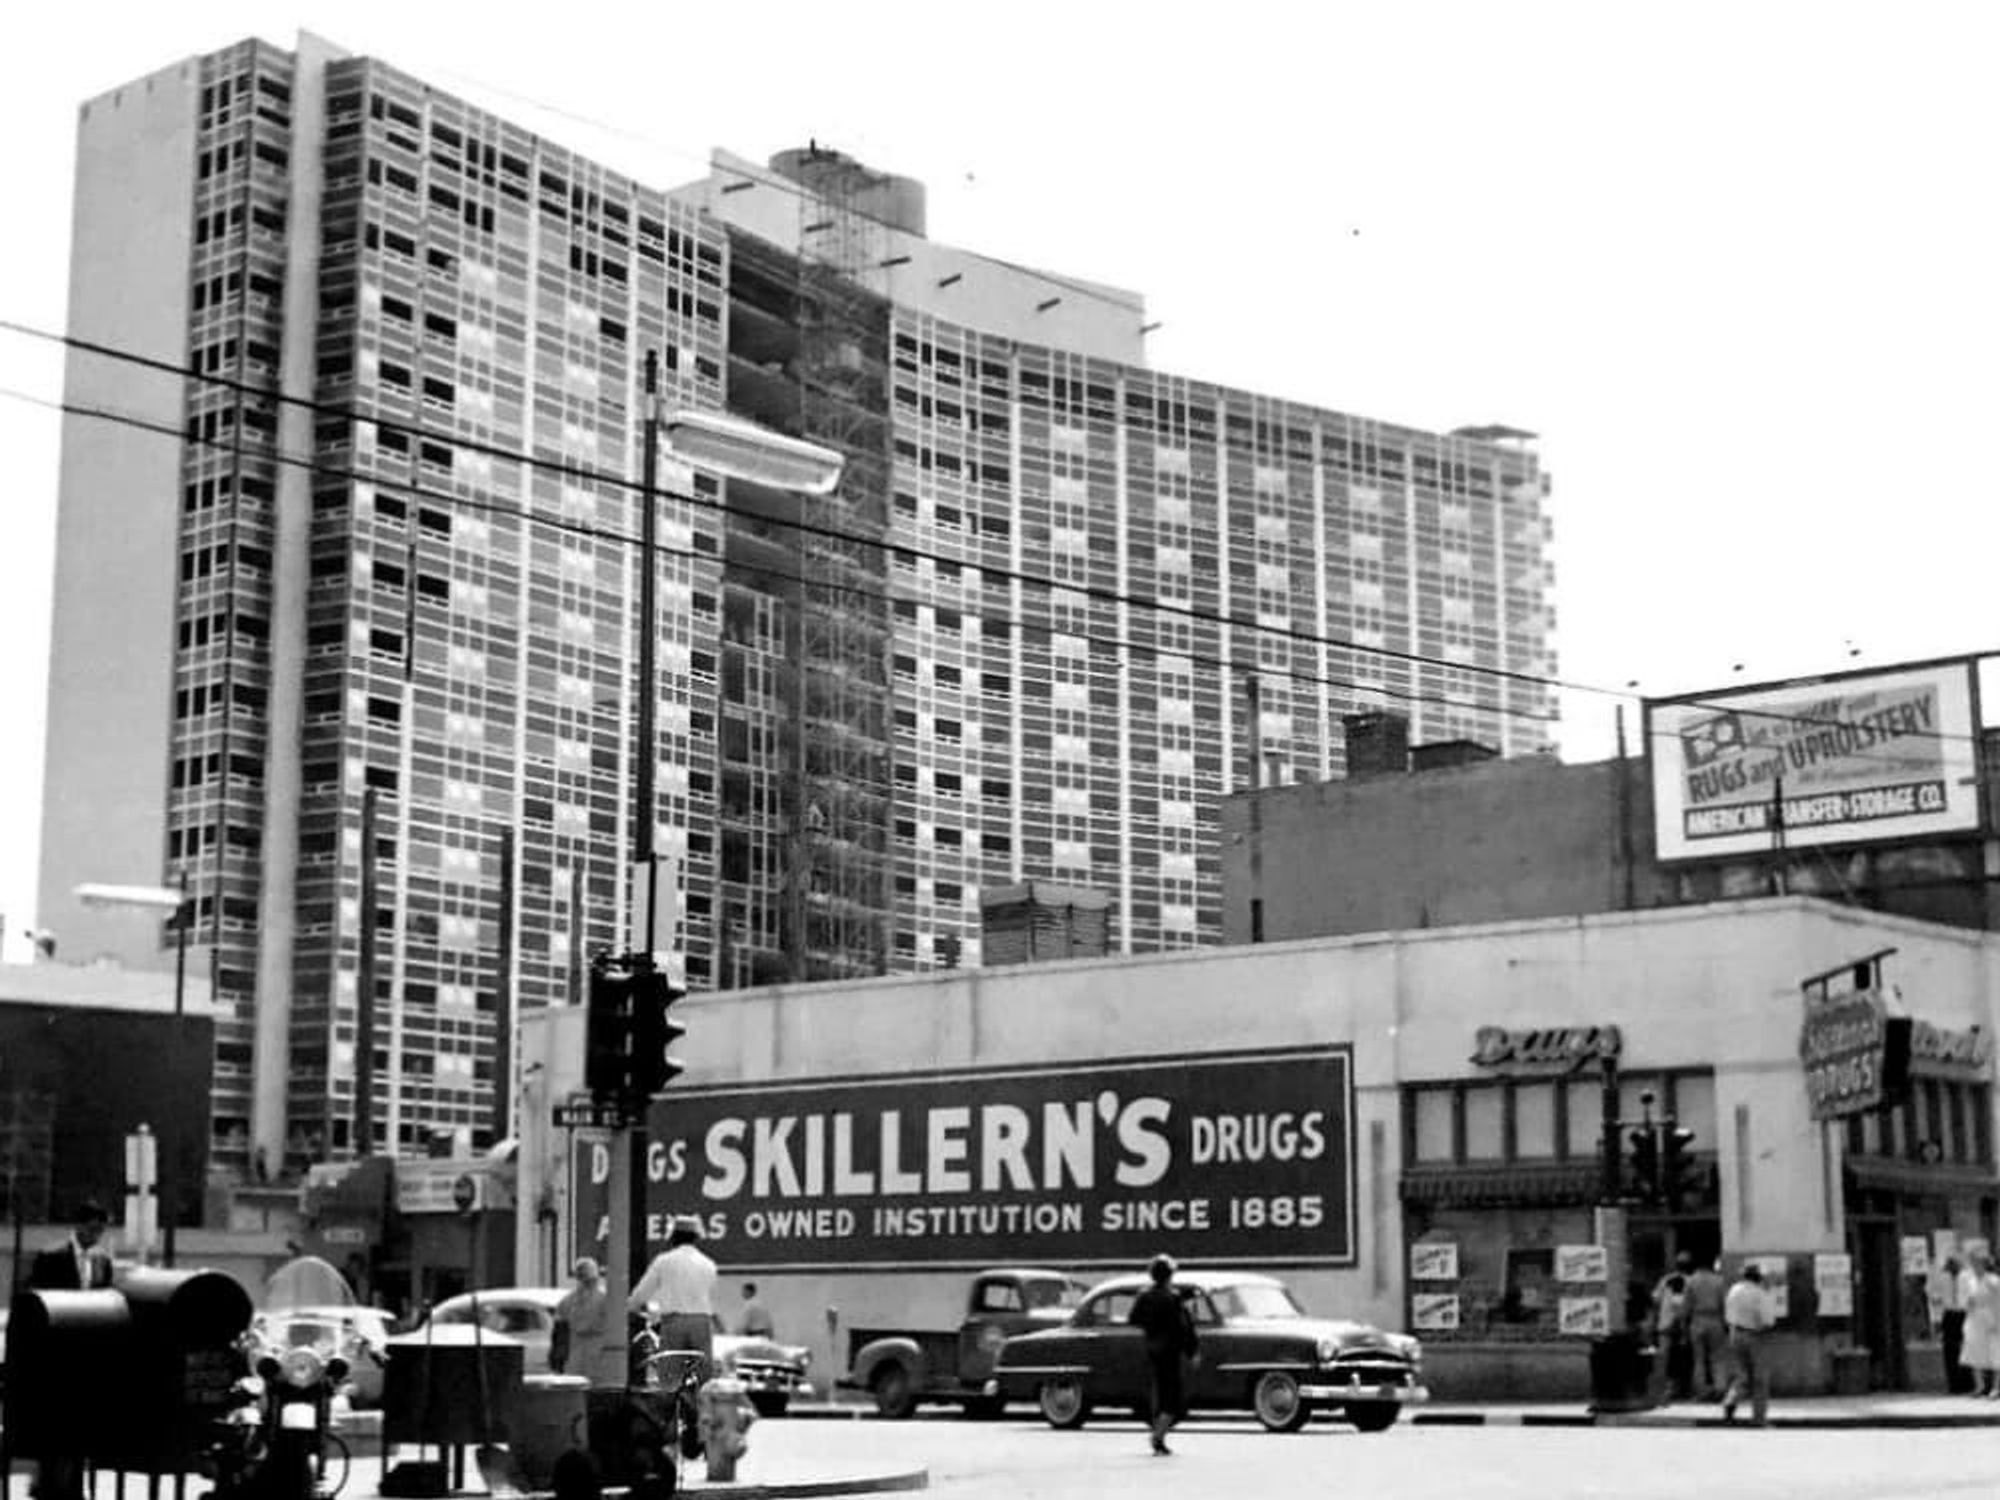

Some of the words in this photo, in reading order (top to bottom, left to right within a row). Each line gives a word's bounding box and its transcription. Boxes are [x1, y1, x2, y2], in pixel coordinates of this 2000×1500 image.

[1688, 758, 1747, 804] RUGS
[1750, 746, 1787, 784] and
[1688, 804, 1766, 835] AMERICAN
[1850, 787, 1915, 818] STORAGE
[592, 1139, 687, 1185] DGS
[702, 1091, 1171, 1200] SKILLERN'S
[1191, 1111, 1325, 1164] DRUGS
[744, 1208, 856, 1239] OWNED
[872, 1202, 1083, 1237] INSTITUTION
[1102, 1199, 1210, 1231] SINCE
[1230, 1196, 1325, 1229] 1885
